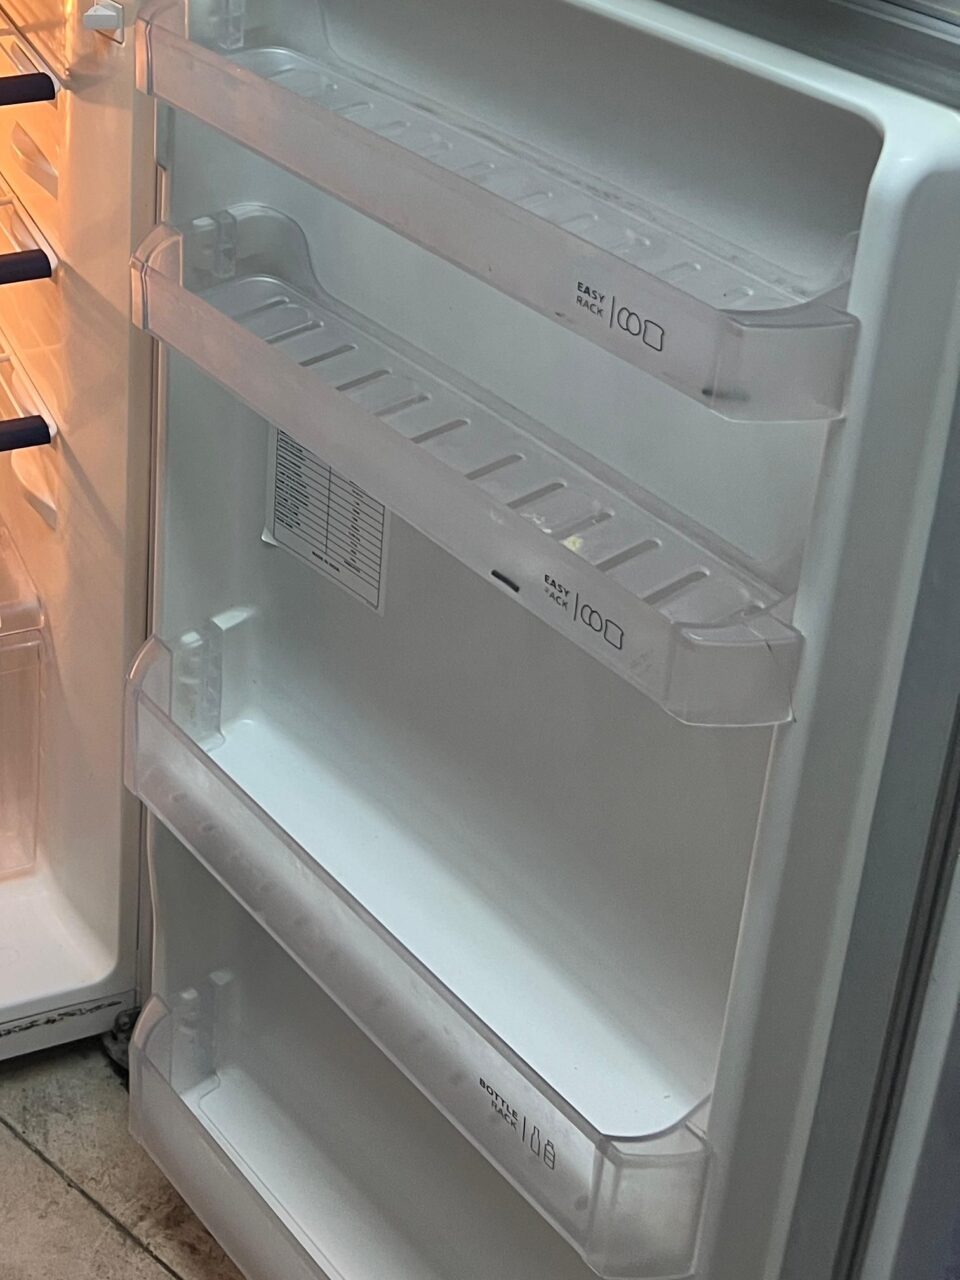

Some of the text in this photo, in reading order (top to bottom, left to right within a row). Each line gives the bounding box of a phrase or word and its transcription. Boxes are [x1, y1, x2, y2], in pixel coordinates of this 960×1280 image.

[577, 281, 605, 303] EASY
[576, 295, 604, 317] RACK
[544, 574, 570, 597] EASY
[480, 1077, 518, 1121] BOTTLE
[491, 1100, 517, 1131] RACK
